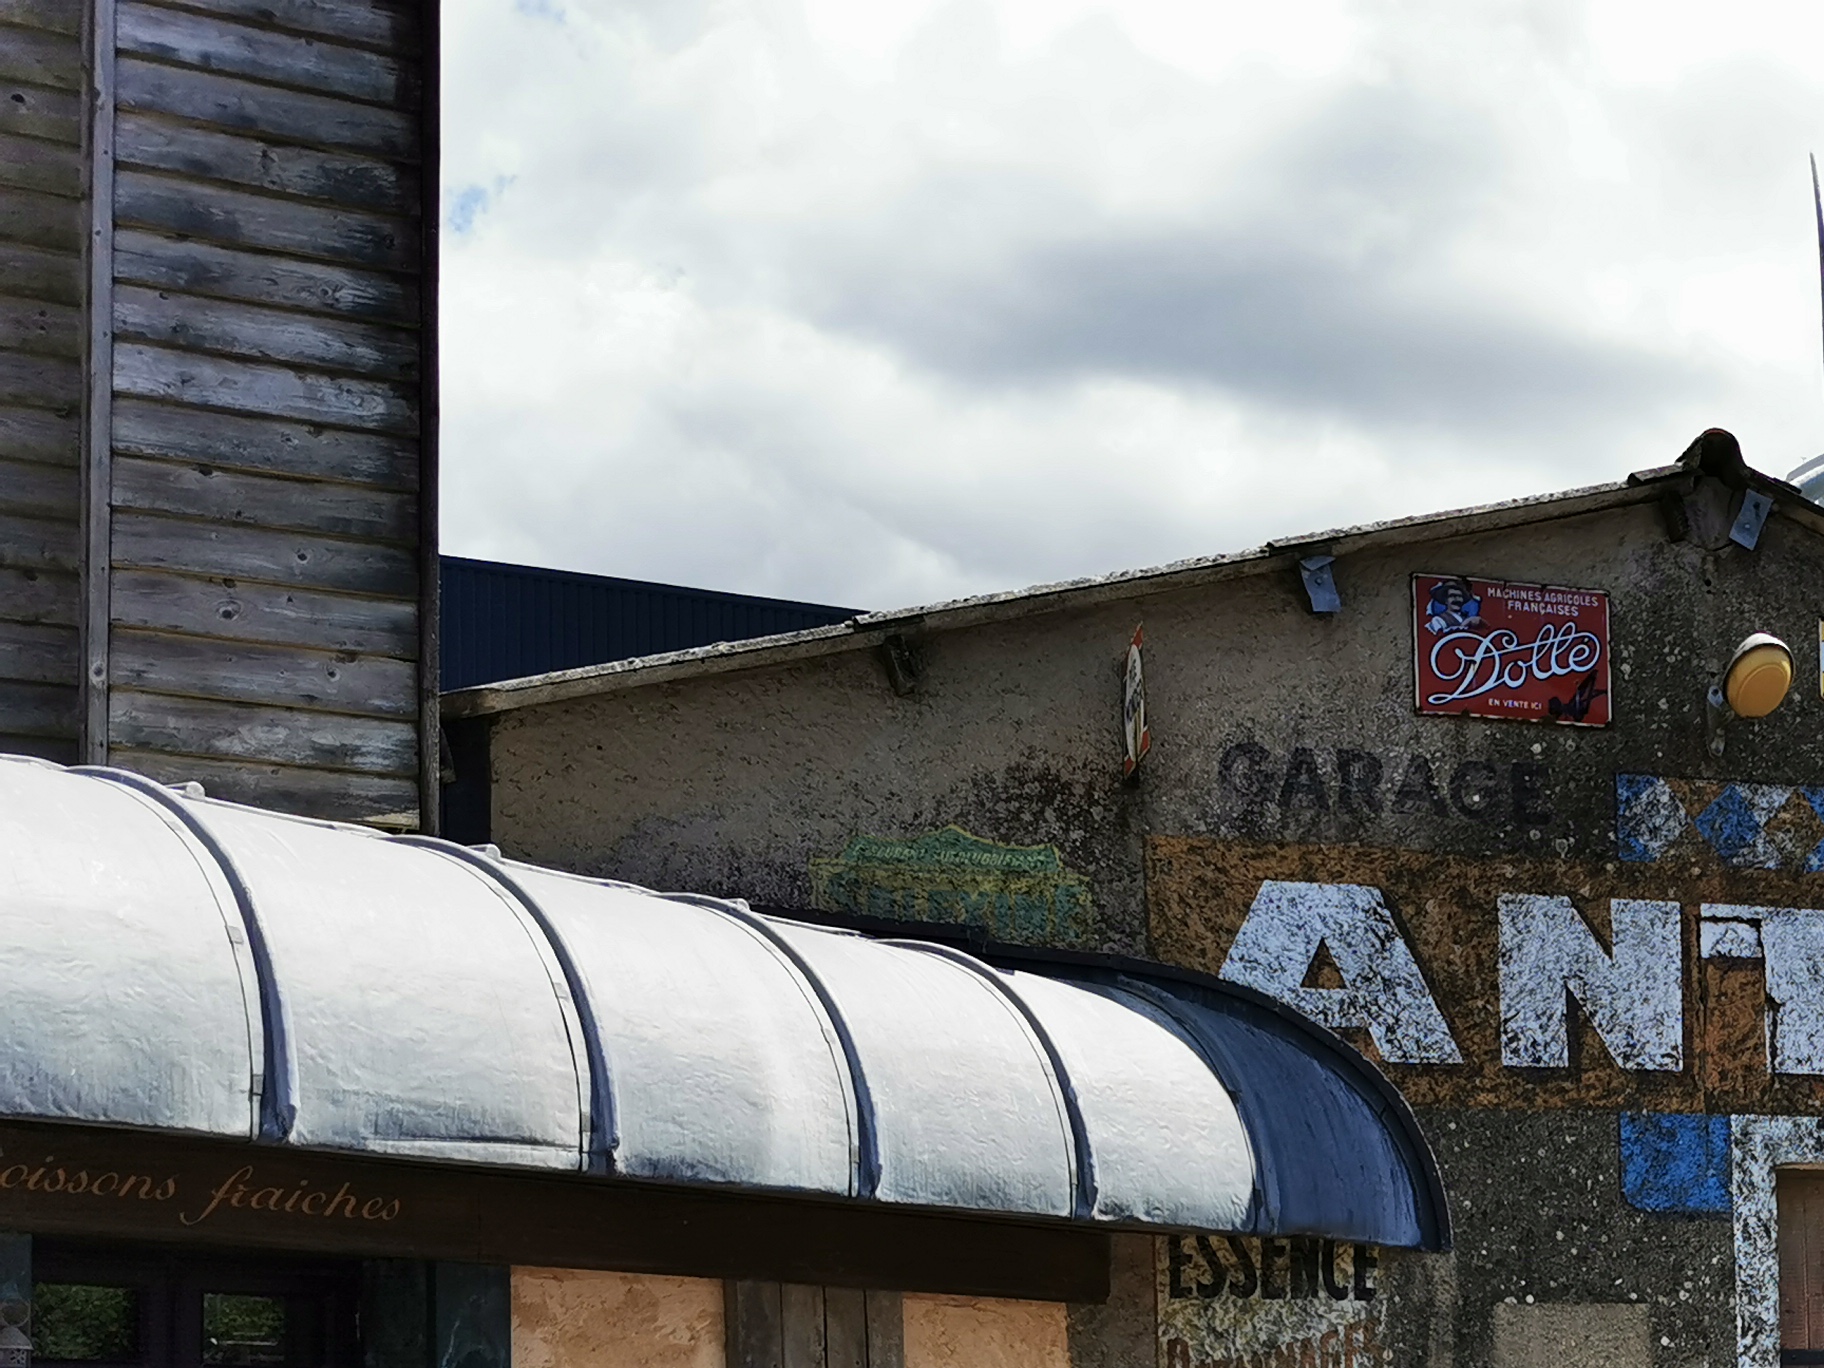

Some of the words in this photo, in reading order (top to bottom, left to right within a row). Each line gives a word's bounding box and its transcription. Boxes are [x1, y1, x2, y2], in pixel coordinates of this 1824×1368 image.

[1487, 587, 1542, 602] MACHINES
[1544, 595, 1599, 607] AGRICOLES
[1507, 600, 1579, 617] FRANÇAISES
[1503, 700, 1528, 709] VENTE
[1218, 740, 1553, 826] GARAGE
[0, 1155, 176, 1202] oissons
[1168, 1234, 1379, 1300] ESSENCE
